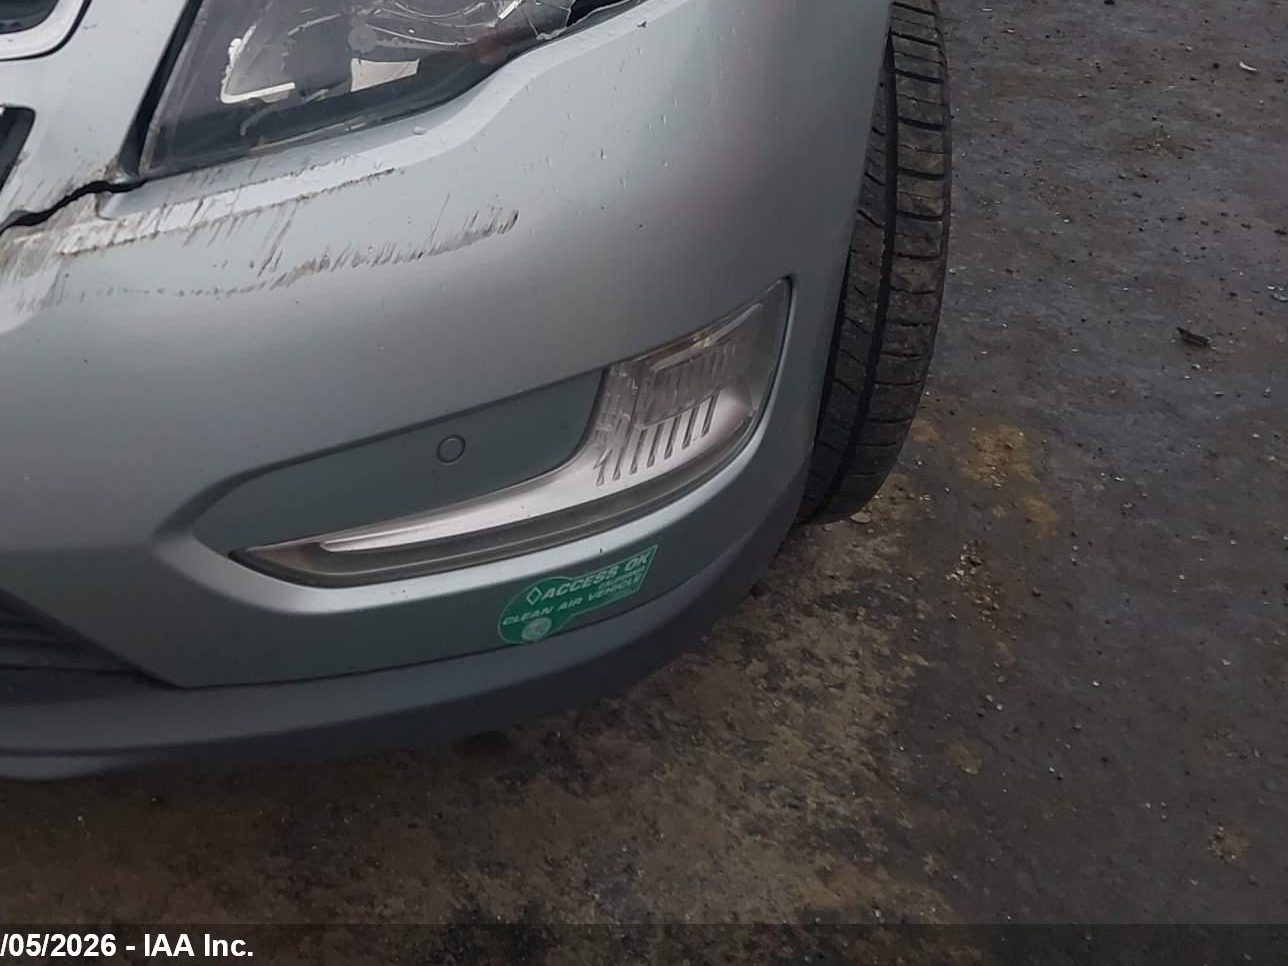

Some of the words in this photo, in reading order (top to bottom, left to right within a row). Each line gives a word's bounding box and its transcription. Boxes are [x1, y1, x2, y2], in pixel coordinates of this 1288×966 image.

[541, 566, 620, 601] ACCESS
[624, 551, 651, 572] OK
[502, 605, 554, 626] CLEAN
[557, 596, 584, 612] AIR
